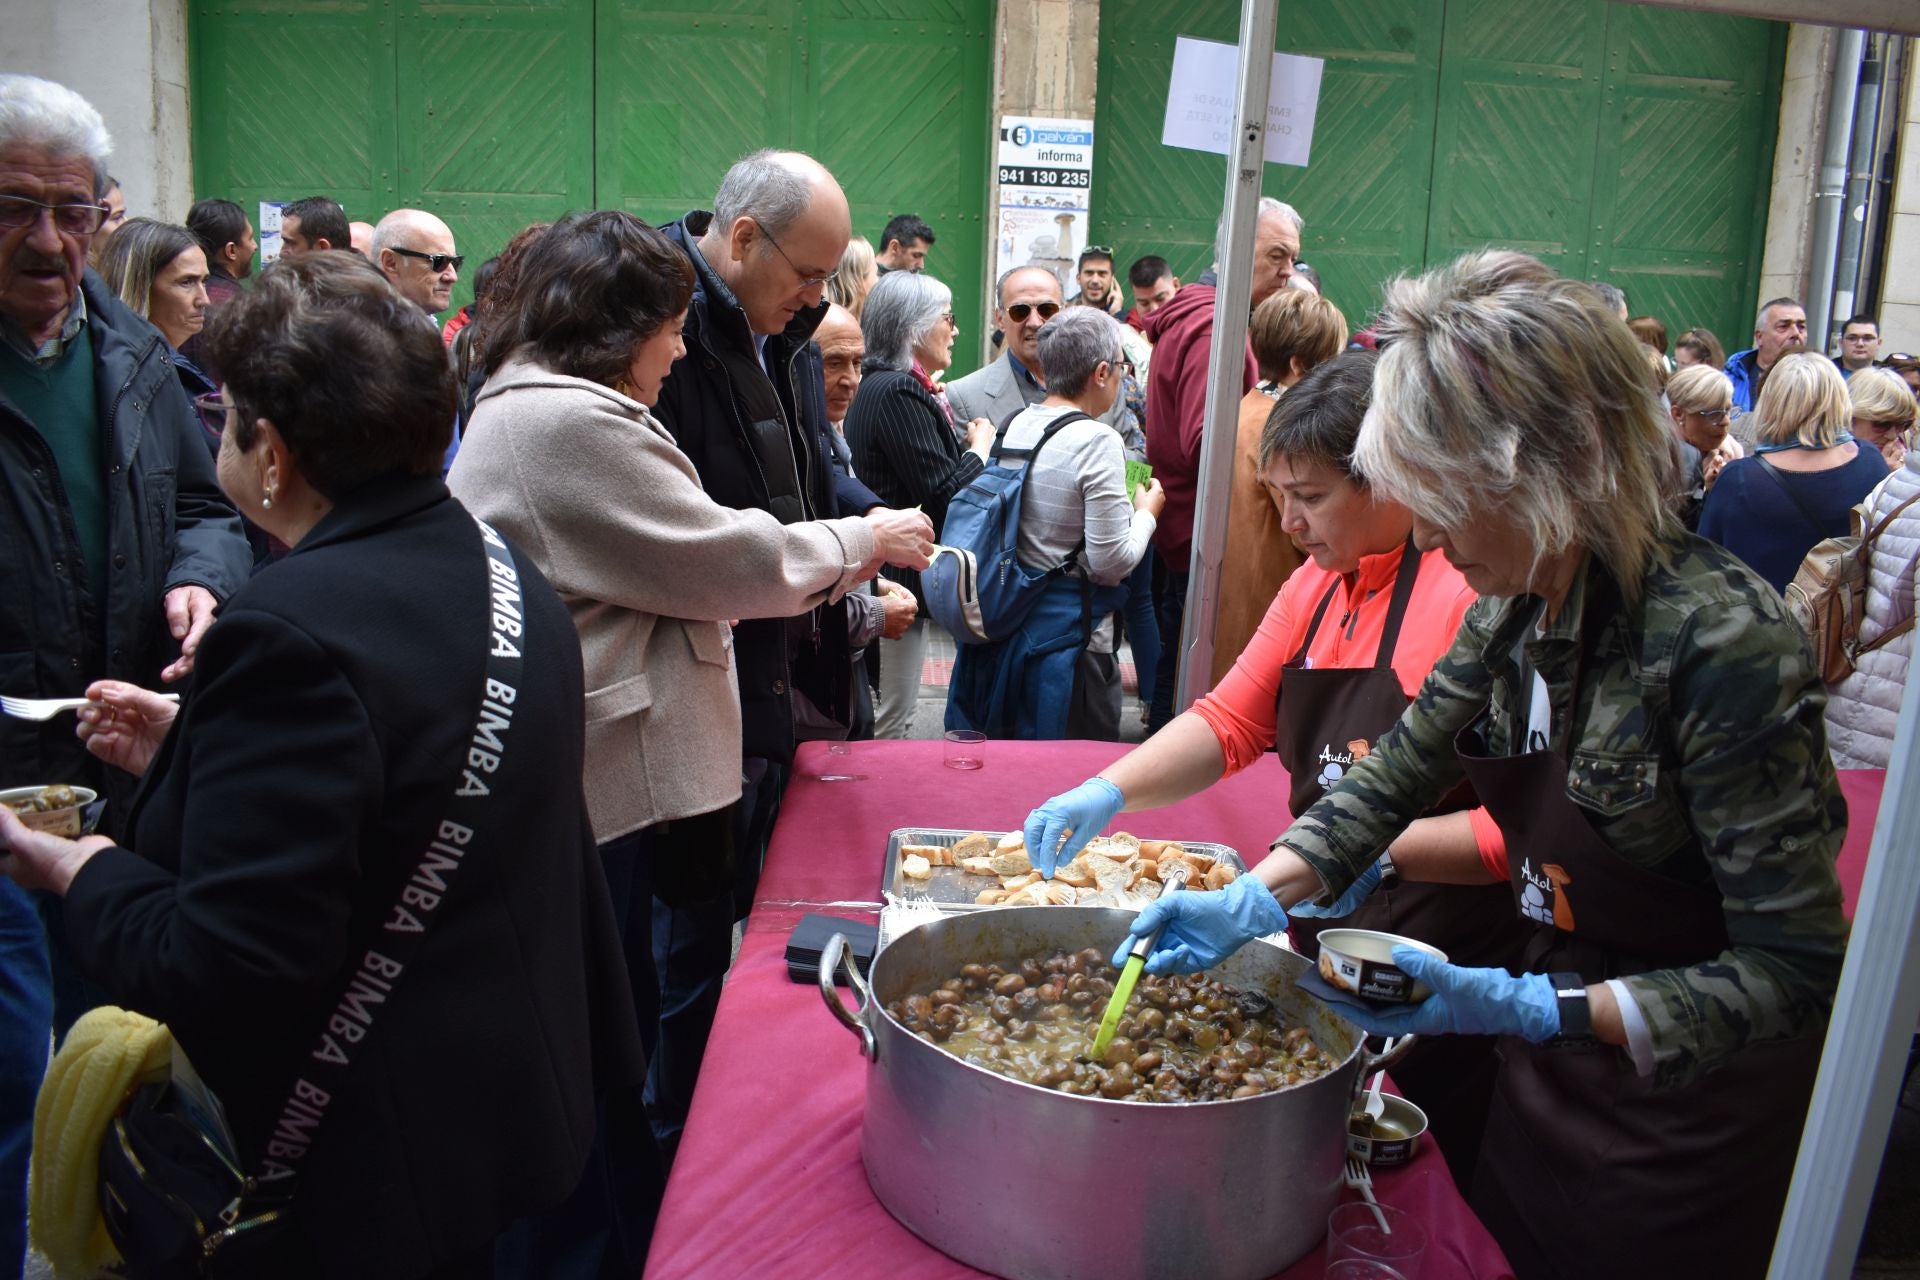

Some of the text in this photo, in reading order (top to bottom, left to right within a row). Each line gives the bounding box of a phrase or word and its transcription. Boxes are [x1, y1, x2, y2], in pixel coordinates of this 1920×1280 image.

[999, 168, 1088, 186] 941 130 235
[1038, 149, 1083, 163] informa
[489, 556, 523, 658] BIMBA
[455, 675, 517, 798] BIMBA
[1319, 743, 1353, 765] Autol
[384, 818, 474, 933] BIMBA
[1521, 856, 1553, 892] Autol
[313, 949, 404, 1066] BIMBA
[258, 1077, 331, 1183] BIMBA
